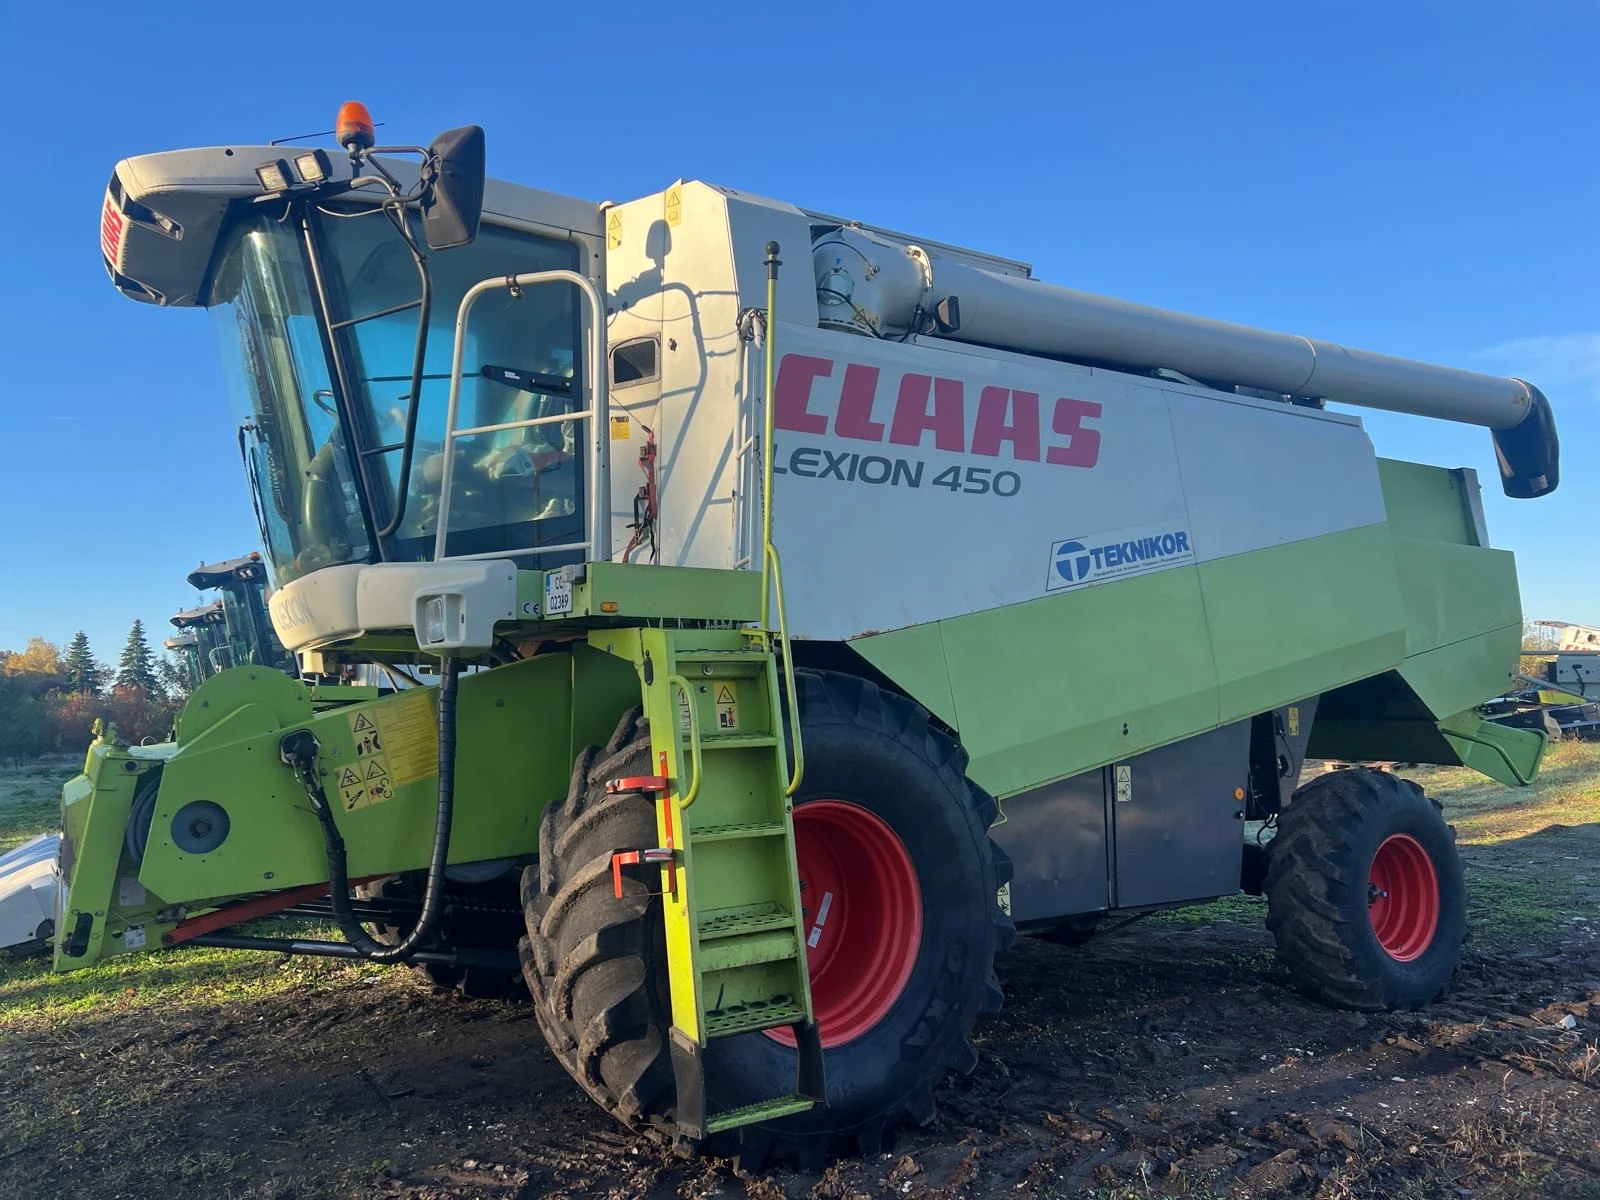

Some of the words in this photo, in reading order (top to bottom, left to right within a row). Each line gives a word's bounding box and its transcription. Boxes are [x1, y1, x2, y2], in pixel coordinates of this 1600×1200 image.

[774, 353, 1102, 469] CLAAS
[773, 443, 925, 488] LEXION
[932, 465, 1022, 498] 450
[1090, 531, 1190, 570] TEKNIKOR
[273, 591, 315, 631] LEXION
